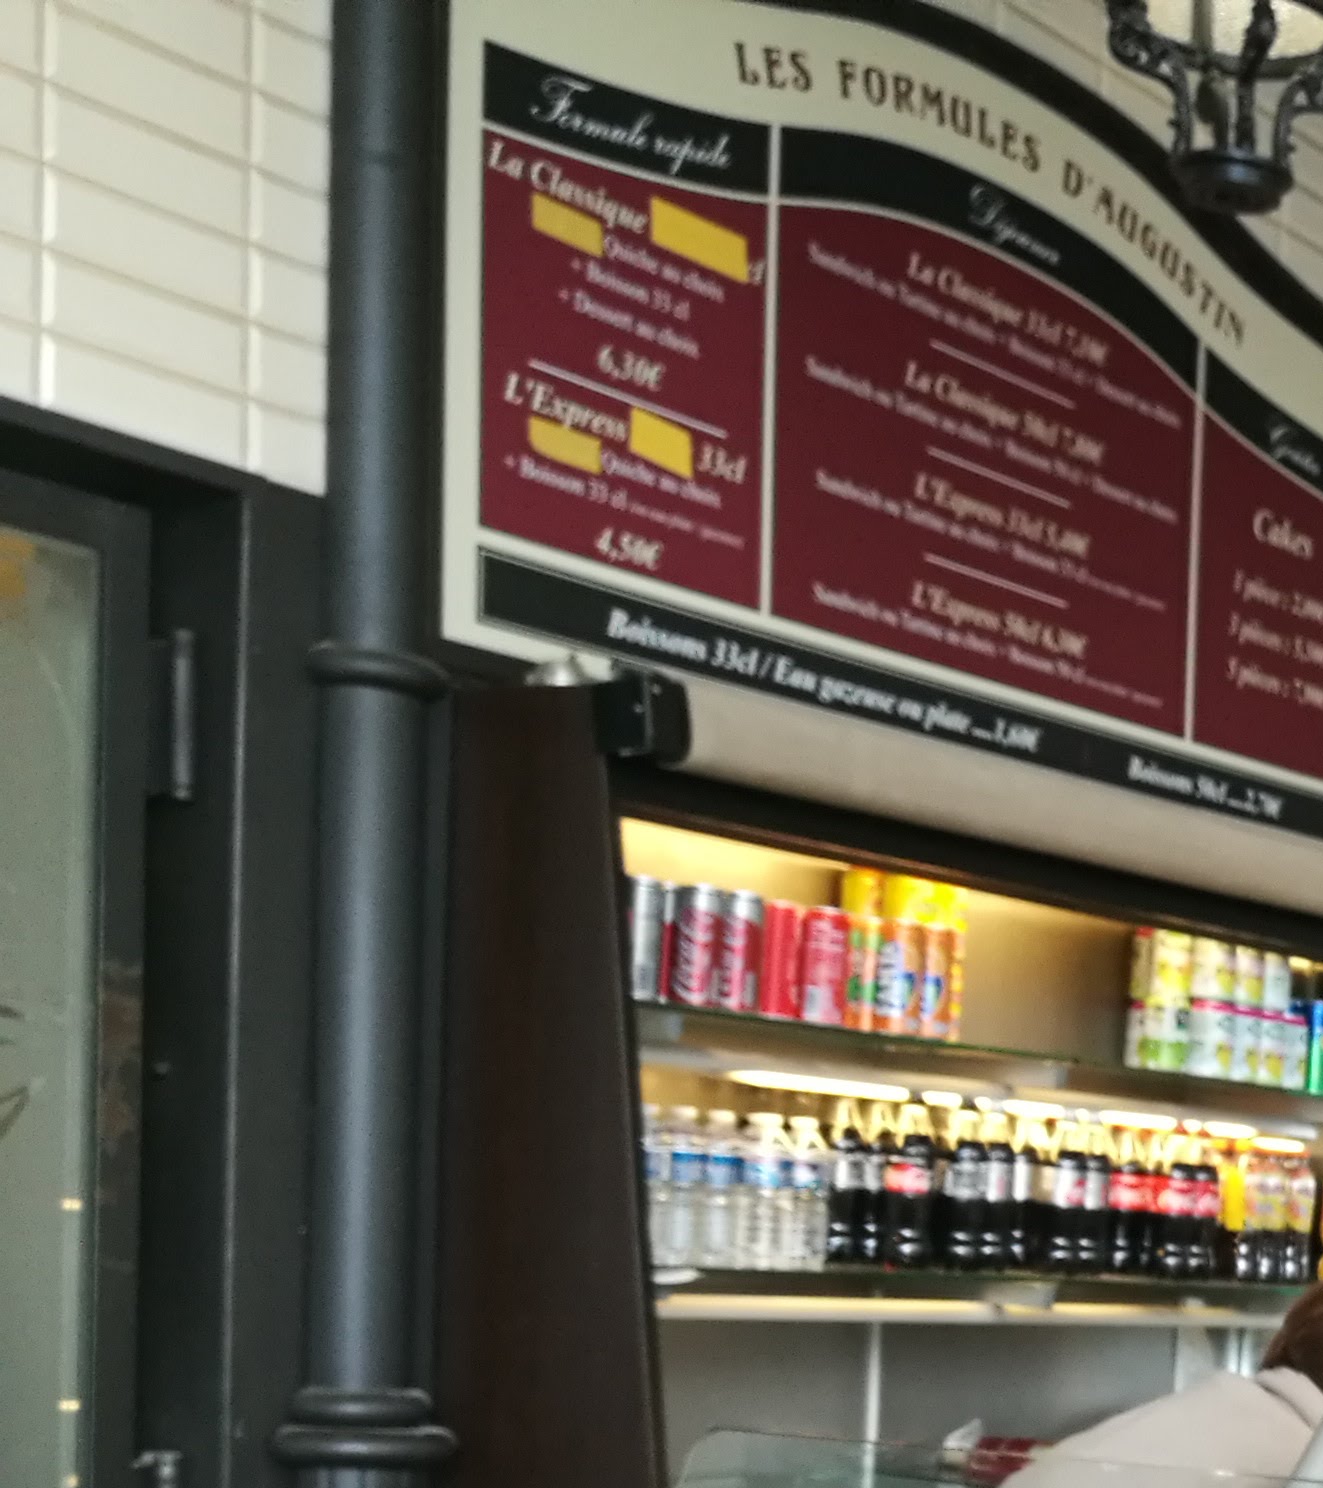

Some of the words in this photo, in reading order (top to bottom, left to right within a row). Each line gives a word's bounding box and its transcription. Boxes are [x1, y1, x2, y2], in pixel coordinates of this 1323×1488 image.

[488, 140, 524, 181] La
[530, 160, 649, 235] Classique
[652, 132, 733, 176] rapide
[735, 41, 812, 93] LES
[838, 59, 1042, 174] FORMULES
[1062, 162, 1247, 348] D'AUGUSTIN
[503, 371, 629, 443] L'Express
